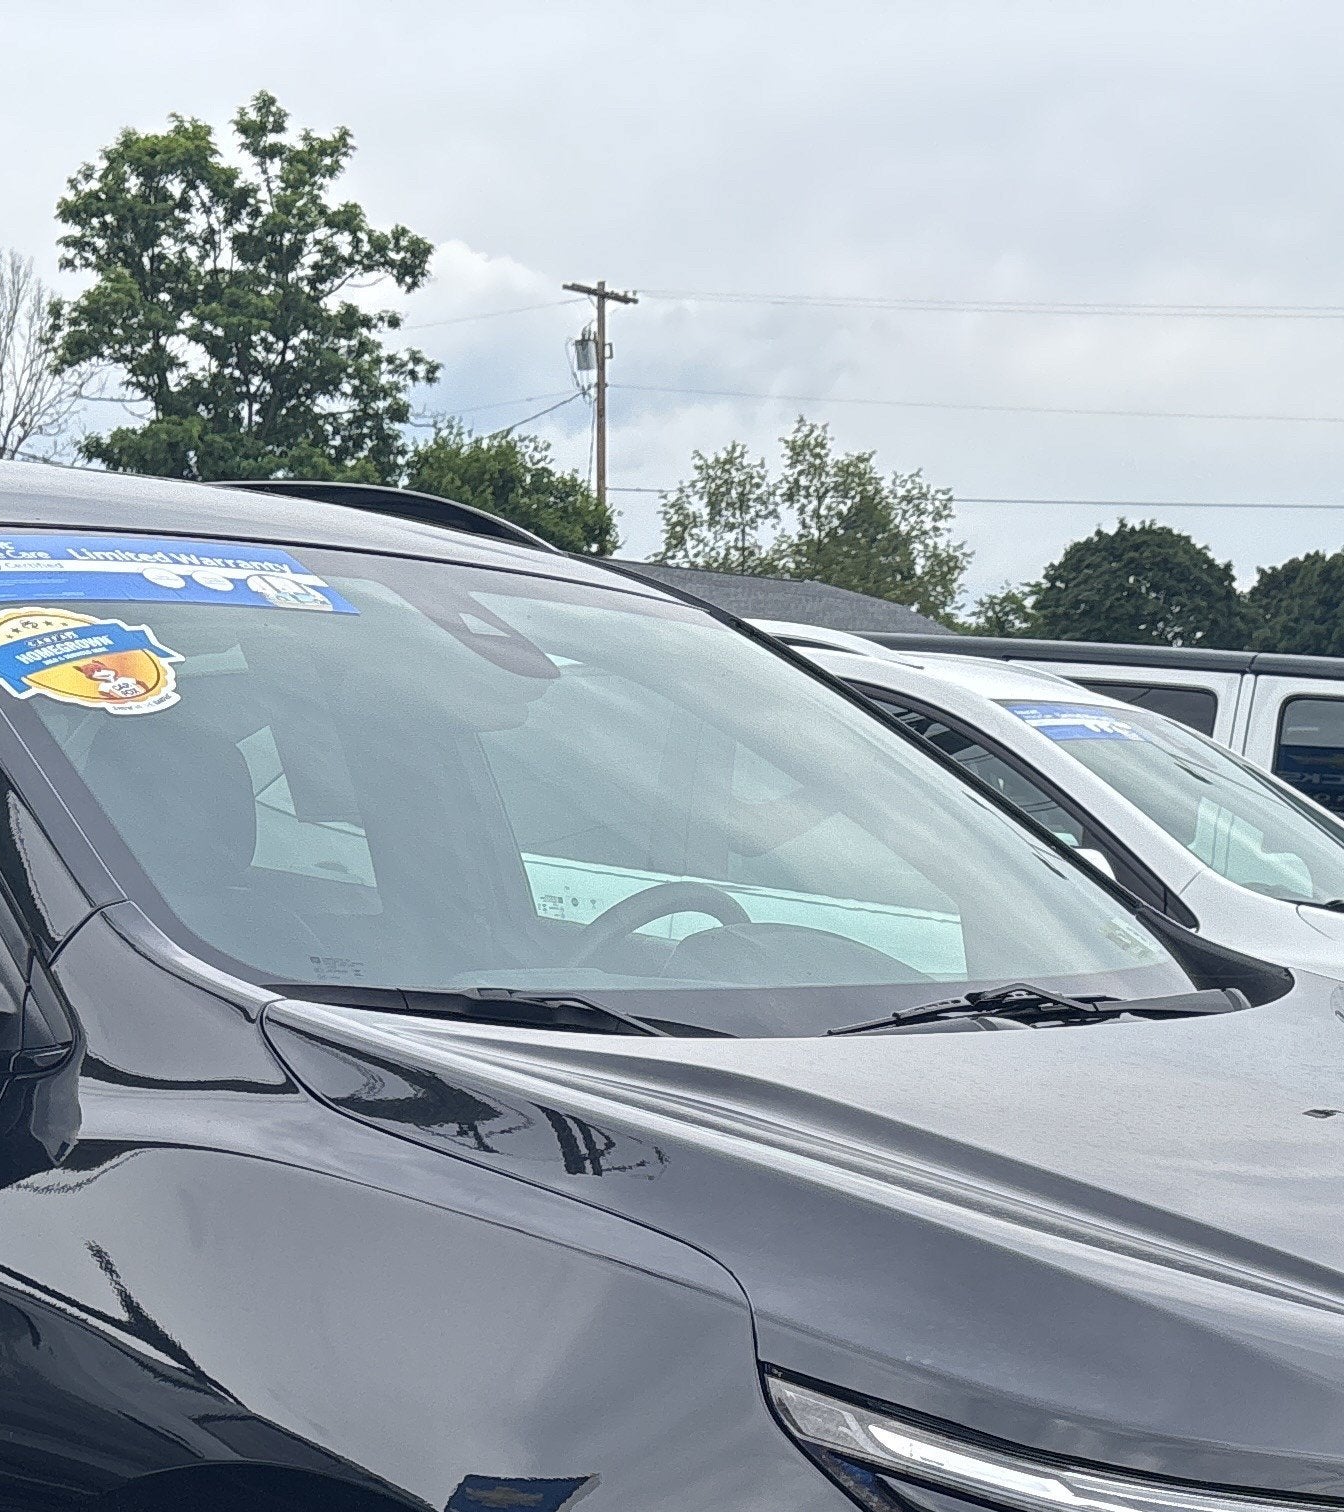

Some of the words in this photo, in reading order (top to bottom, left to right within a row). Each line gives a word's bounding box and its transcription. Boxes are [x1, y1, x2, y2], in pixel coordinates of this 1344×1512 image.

[5, 550, 52, 561] Care
[67, 547, 173, 564] Limited
[168, 552, 292, 575] Warranty
[14, 634, 116, 665] HOMEGROWN
